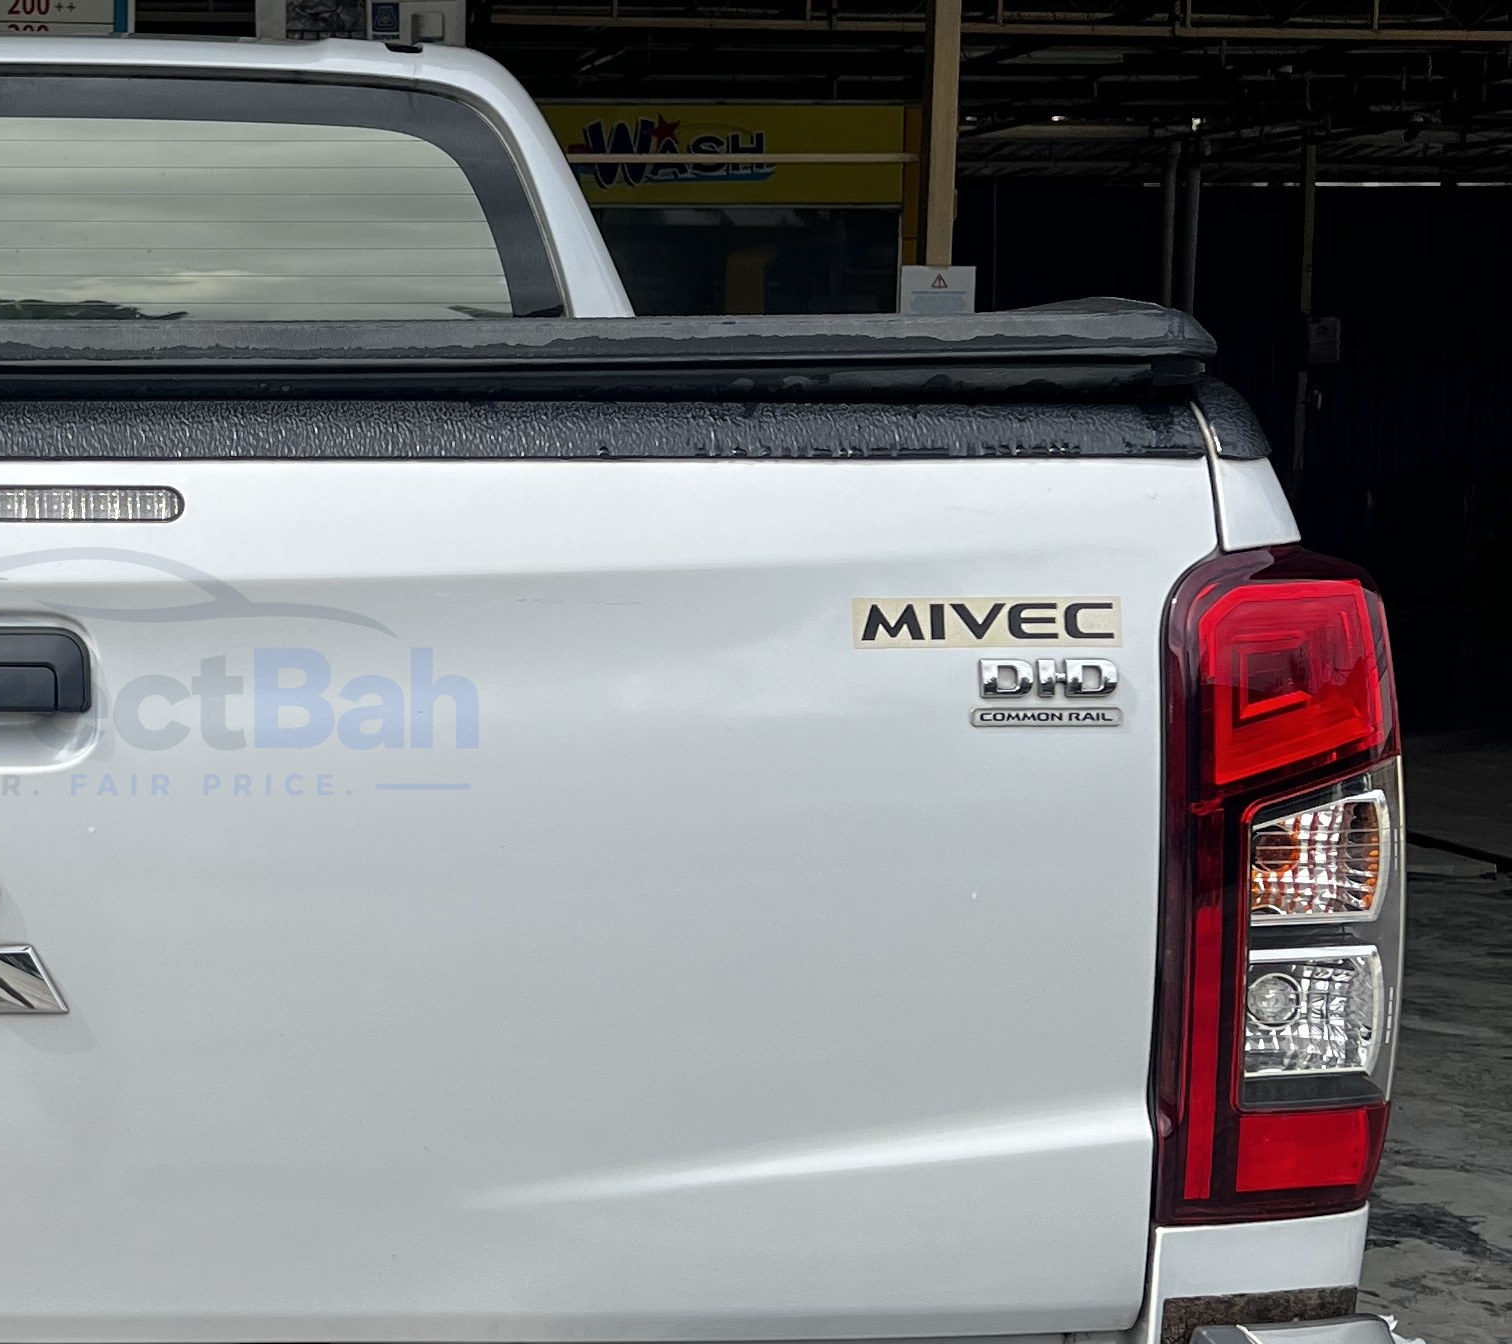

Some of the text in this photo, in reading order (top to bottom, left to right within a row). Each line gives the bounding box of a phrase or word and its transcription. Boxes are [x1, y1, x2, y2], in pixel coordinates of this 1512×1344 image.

[582, 119, 766, 190] WASH
[861, 602, 1116, 641] MIVEC
[979, 711, 1114, 723] COMMON RAIL
